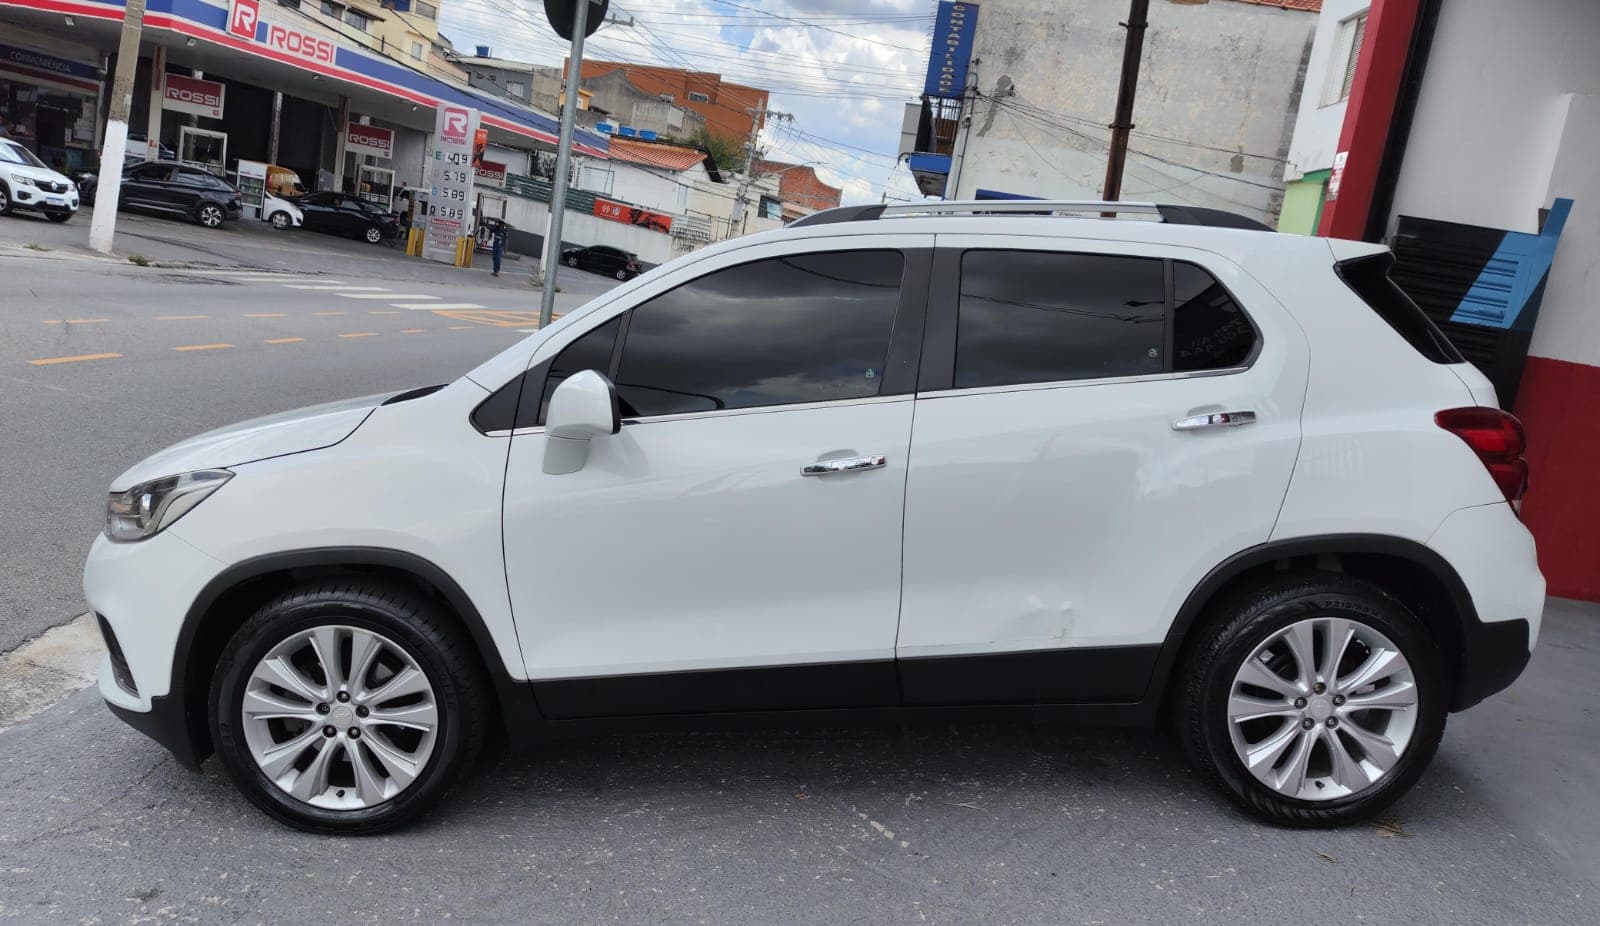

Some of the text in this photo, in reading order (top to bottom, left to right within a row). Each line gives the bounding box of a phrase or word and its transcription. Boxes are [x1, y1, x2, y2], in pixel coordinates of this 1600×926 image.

[234, 3, 256, 32] R
[270, 25, 334, 63] ROSSI
[166, 87, 220, 107] ROSSI
[443, 110, 467, 134] R
[349, 133, 390, 149] ROSSI
[440, 135, 468, 146] ROSSI
